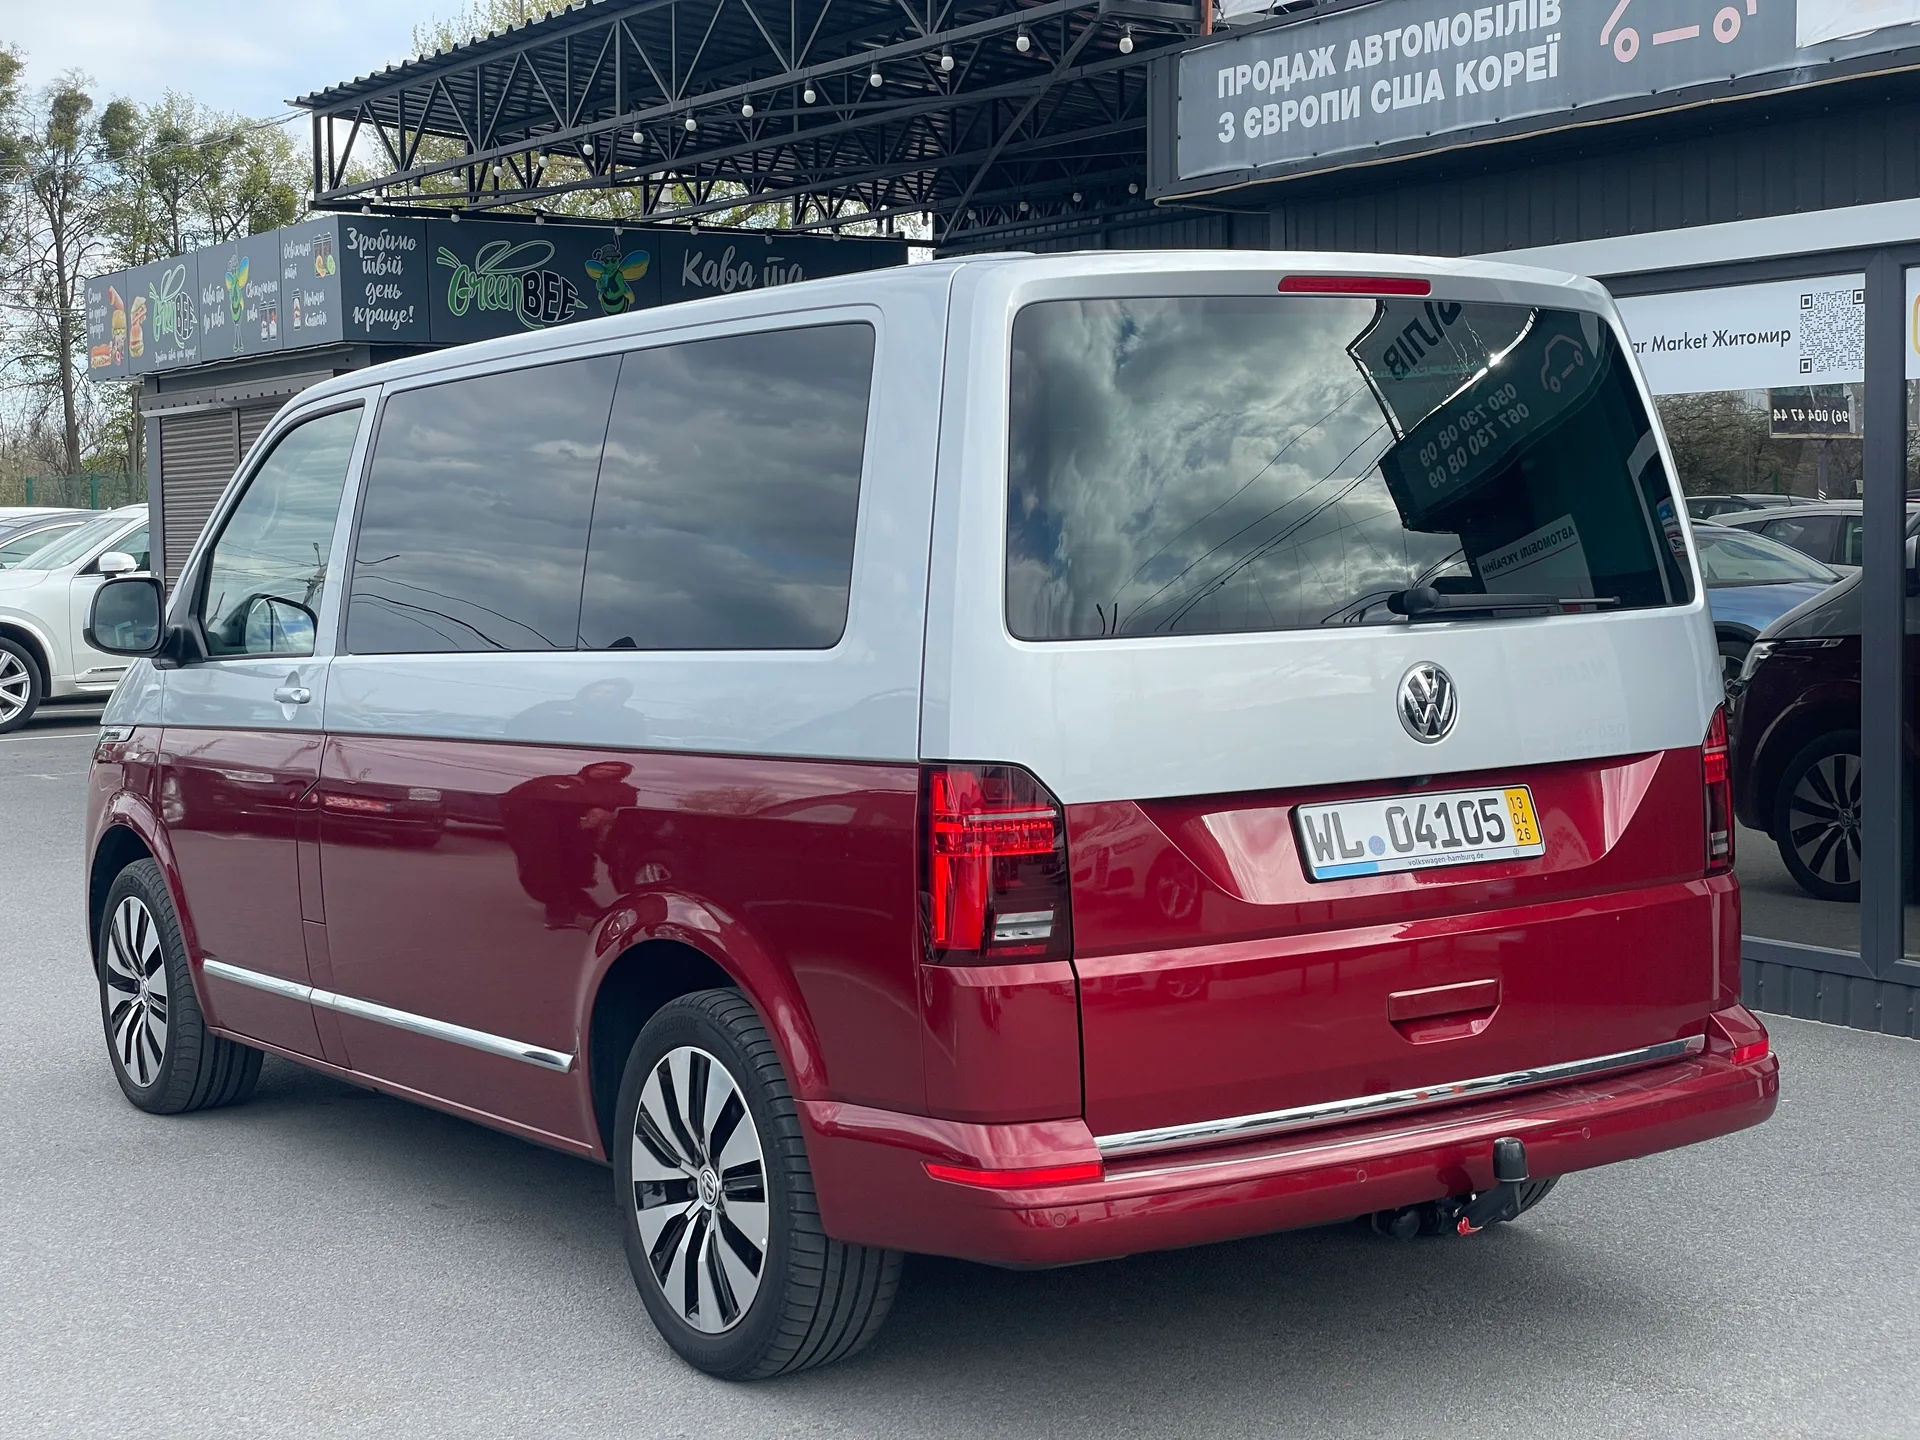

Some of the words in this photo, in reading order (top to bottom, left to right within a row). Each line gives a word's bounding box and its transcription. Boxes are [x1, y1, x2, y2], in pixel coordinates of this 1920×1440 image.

[1218, 44, 1337, 99] ПРОДАЖ
[1344, 0, 1562, 72] АВТОМОБІЛІВ
[1218, 111, 1236, 144] З
[1243, 85, 1361, 139] ЄВРОПИ
[1370, 68, 1446, 114] США
[1455, 32, 1562, 97] КОРЕЇ
[346, 227, 417, 258] Зробимо
[362, 251, 404, 275] твій
[682, 245, 757, 293] Кава
[763, 256, 808, 287] та
[365, 282, 402, 305] день
[353, 305, 415, 332] краще!
[1633, 341, 1647, 354] ar
[1651, 332, 1708, 353] Market
[1712, 329, 1791, 348] Житомир
[1509, 796, 1524, 810] 13
[1304, 811, 1365, 862] WL
[1385, 797, 1506, 853] 04105
[1513, 812, 1528, 825] 04
[1517, 827, 1531, 841] 26
[1408, 852, 1484, 867] volkswagen-hamburg.de
